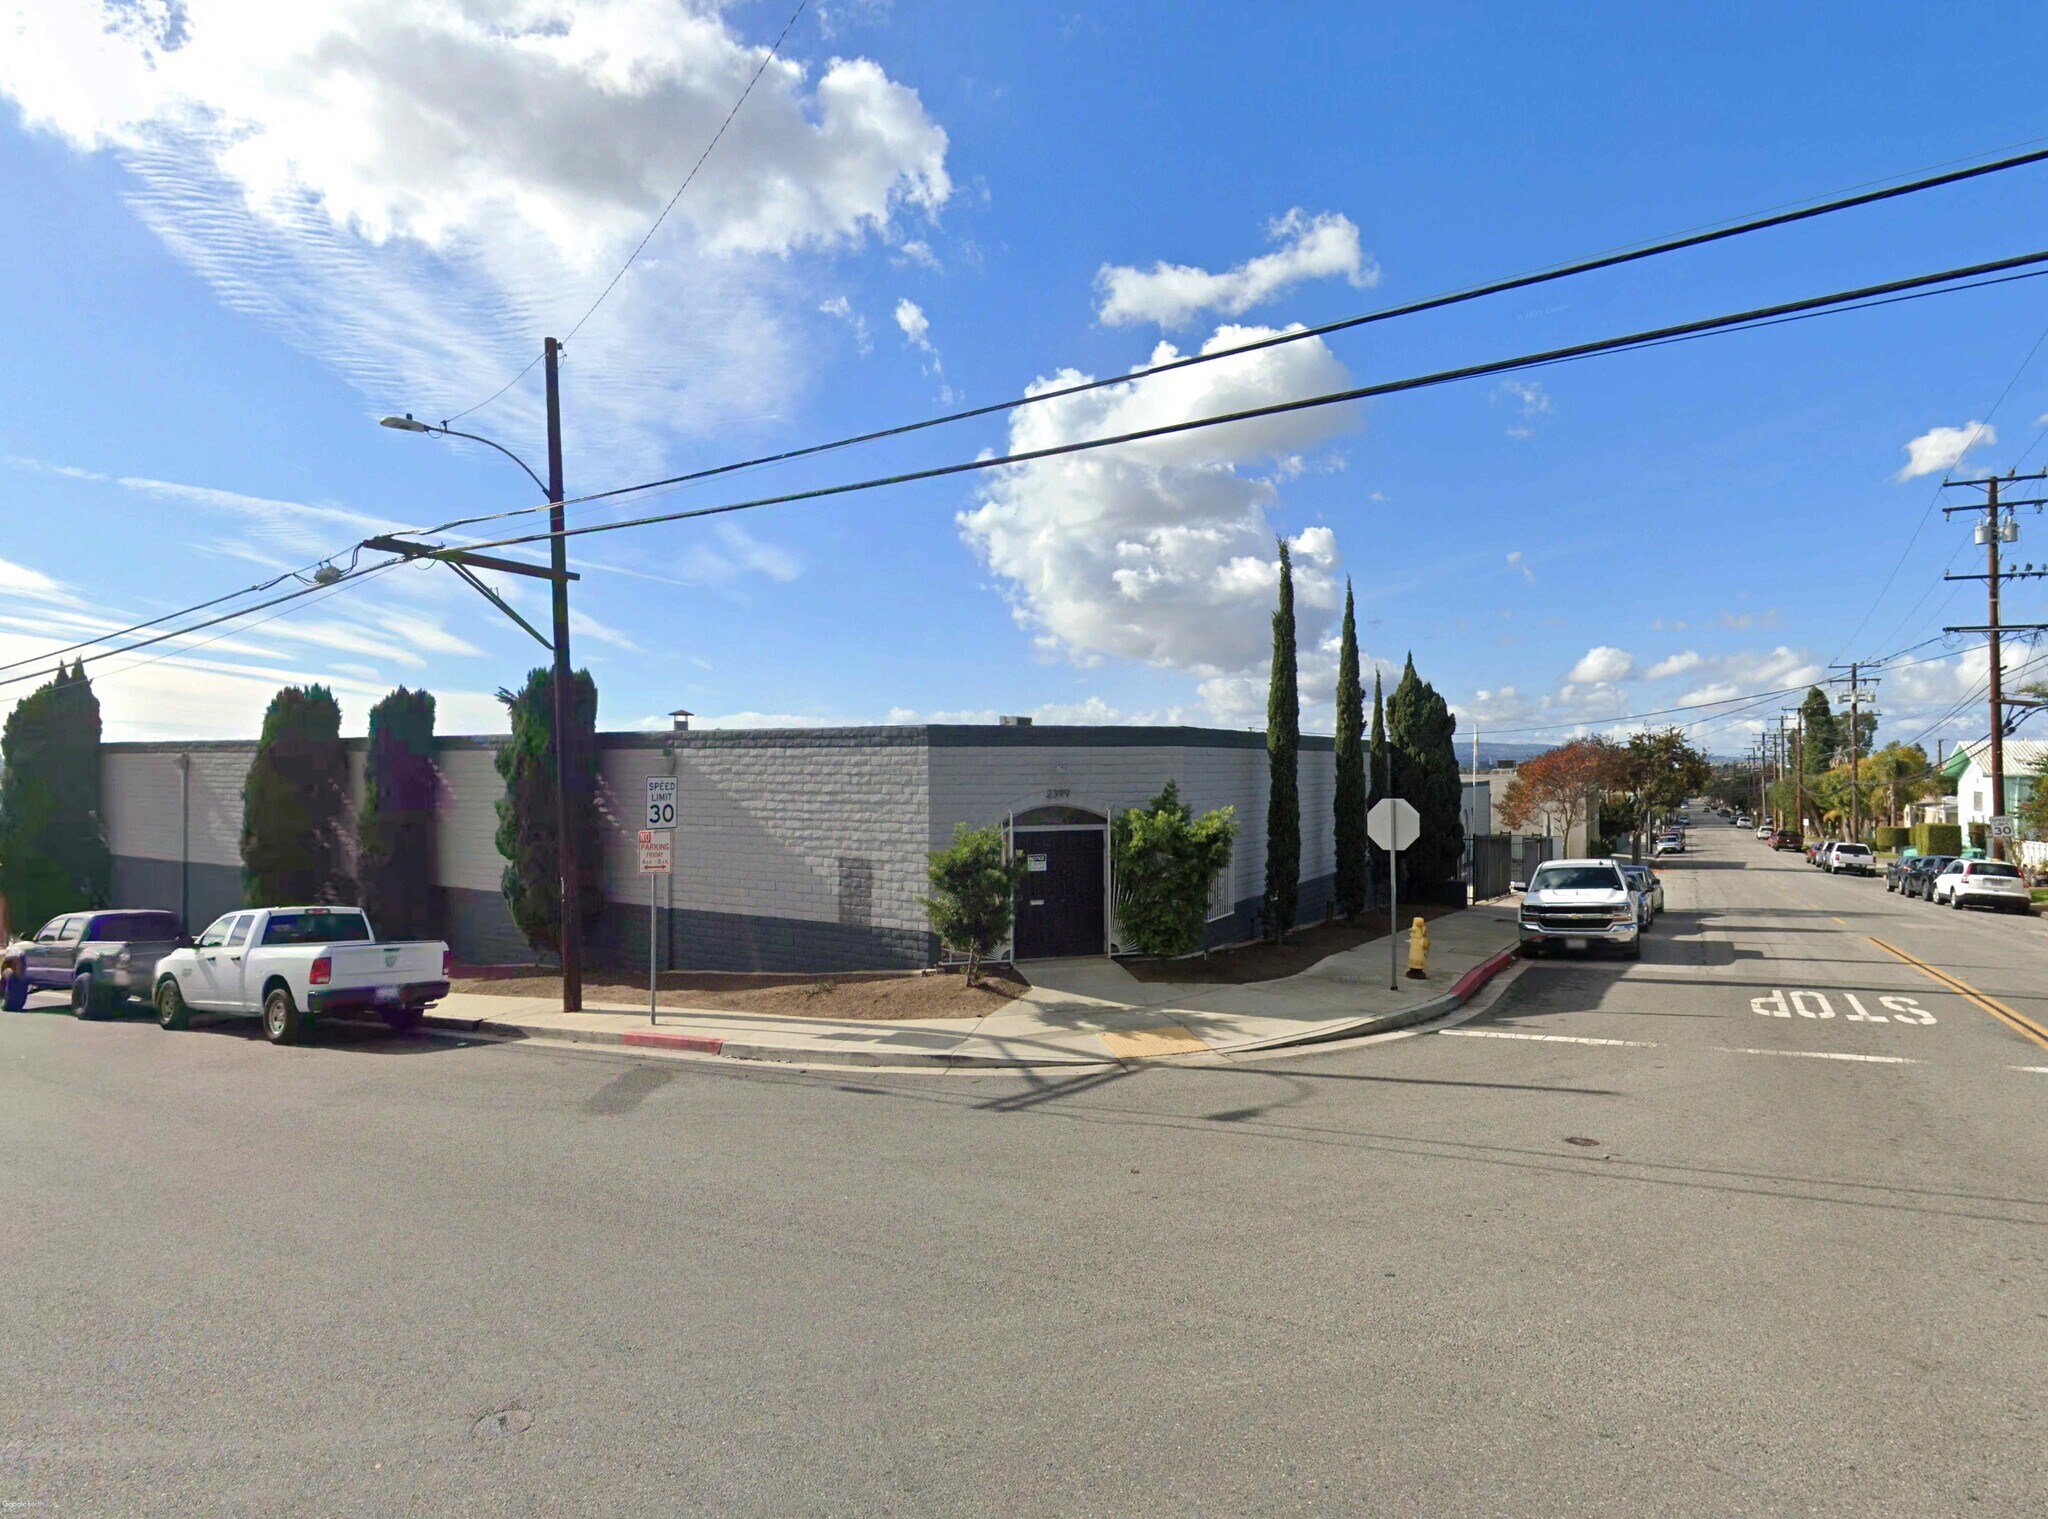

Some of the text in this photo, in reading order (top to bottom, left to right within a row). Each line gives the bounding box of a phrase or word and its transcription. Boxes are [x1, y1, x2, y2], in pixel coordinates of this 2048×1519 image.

[649, 782, 675, 791] SPEED
[651, 793, 673, 802] LIMIT
[1046, 788, 1070, 799] 2399
[649, 803, 674, 823] 30
[1994, 826, 2012, 836] 30
[640, 832, 650, 842] NO
[641, 843, 670, 851] PARKING
[1750, 990, 1937, 1025] STOP
